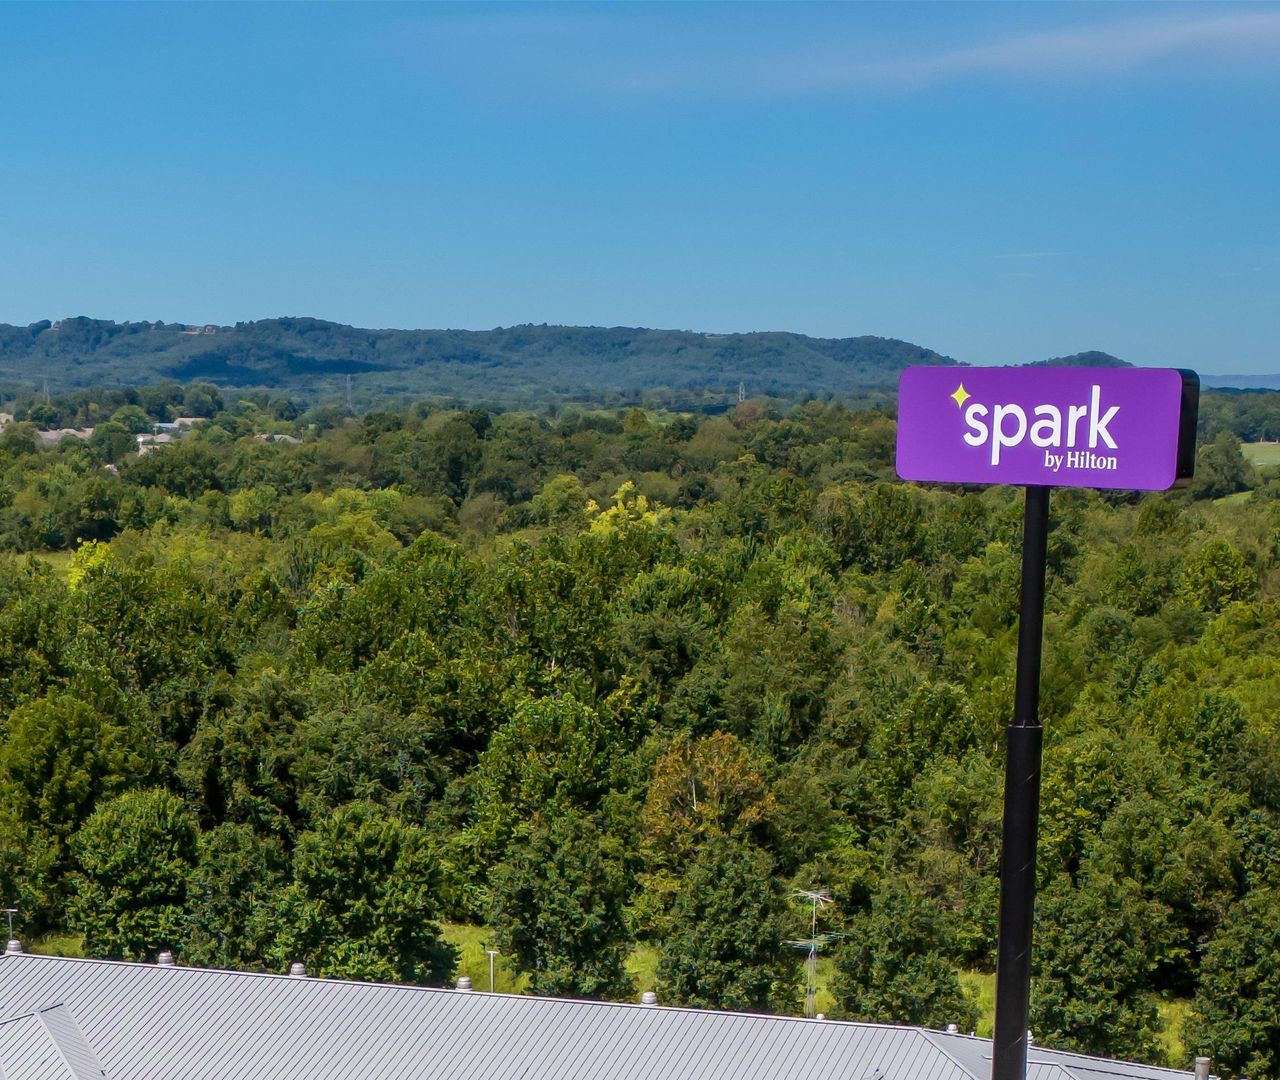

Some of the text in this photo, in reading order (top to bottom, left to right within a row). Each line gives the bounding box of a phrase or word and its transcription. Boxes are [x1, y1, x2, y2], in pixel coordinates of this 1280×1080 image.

[963, 385, 1121, 466] spark
[1044, 450, 1117, 472] by Hilton
